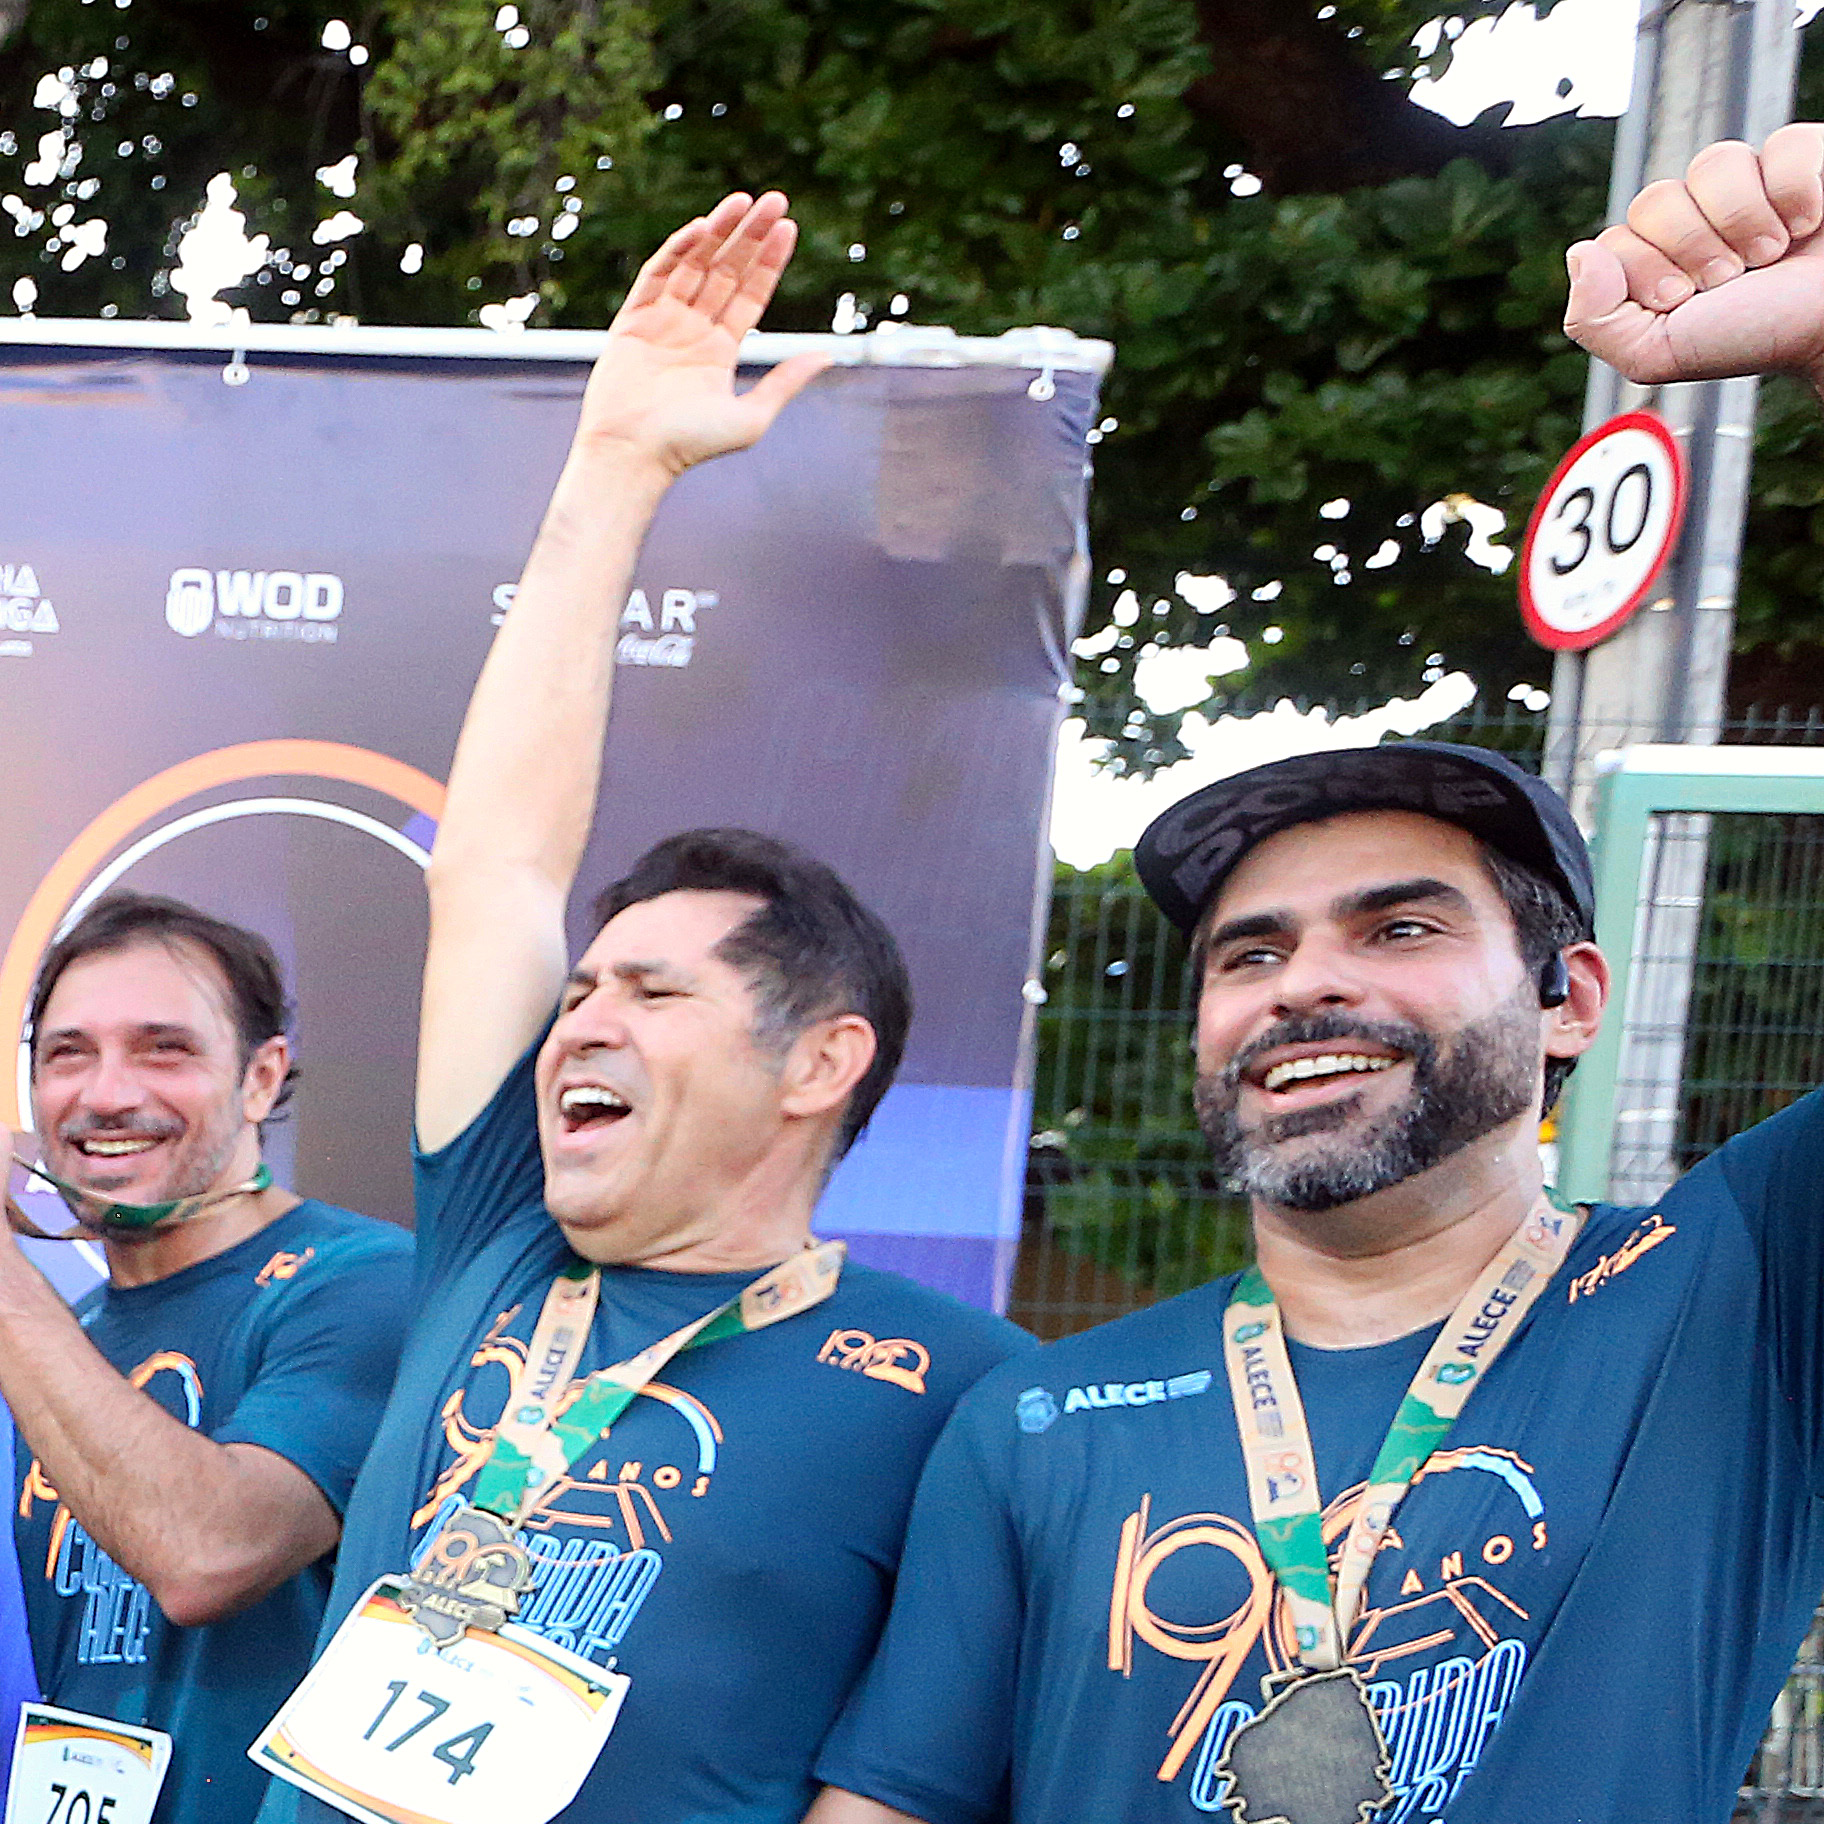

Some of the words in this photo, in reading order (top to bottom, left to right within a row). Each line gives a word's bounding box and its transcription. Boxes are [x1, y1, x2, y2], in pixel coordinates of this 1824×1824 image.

[1551, 462, 1653, 577] 30
[214, 570, 345, 620] WOD
[1455, 1288, 1518, 1359] ALECE
[1063, 1380, 1167, 1414] ALECE
[1242, 1346, 1278, 1411] ALECE
[587, 1458, 711, 1498] ANOS
[1400, 1521, 1548, 1596] ANOS
[362, 1680, 496, 1786] 174
